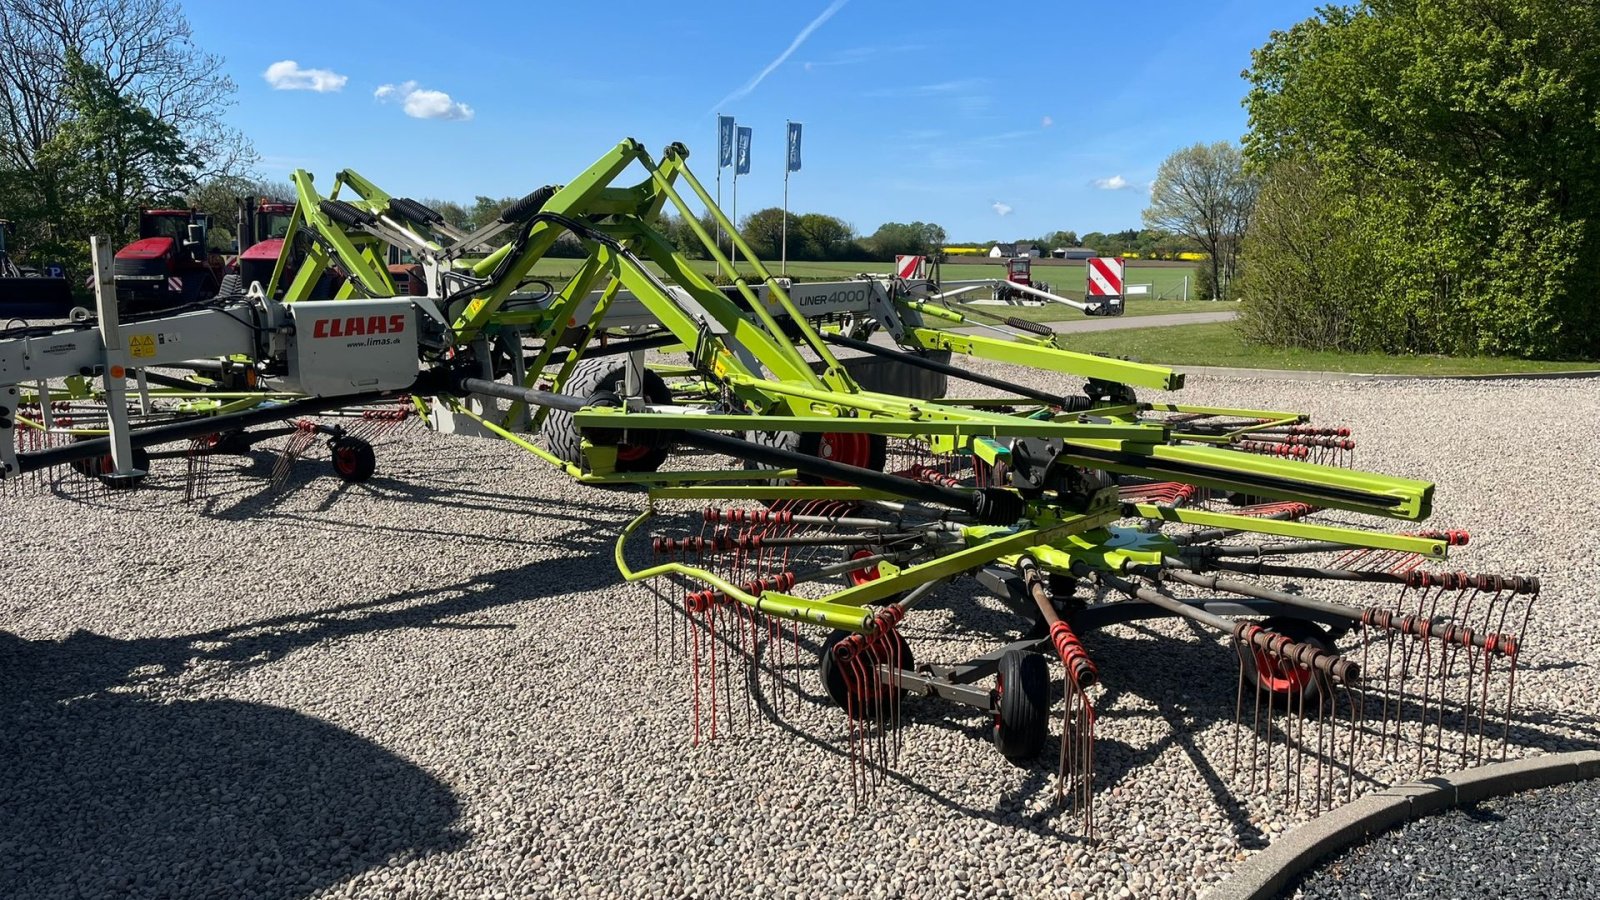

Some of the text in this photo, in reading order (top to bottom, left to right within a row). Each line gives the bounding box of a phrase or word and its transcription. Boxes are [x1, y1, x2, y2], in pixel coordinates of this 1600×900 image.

[800, 290, 865, 306] LINER 4000
[313, 315, 405, 338] CLAAS
[346, 337, 401, 348] www.limas.dk
